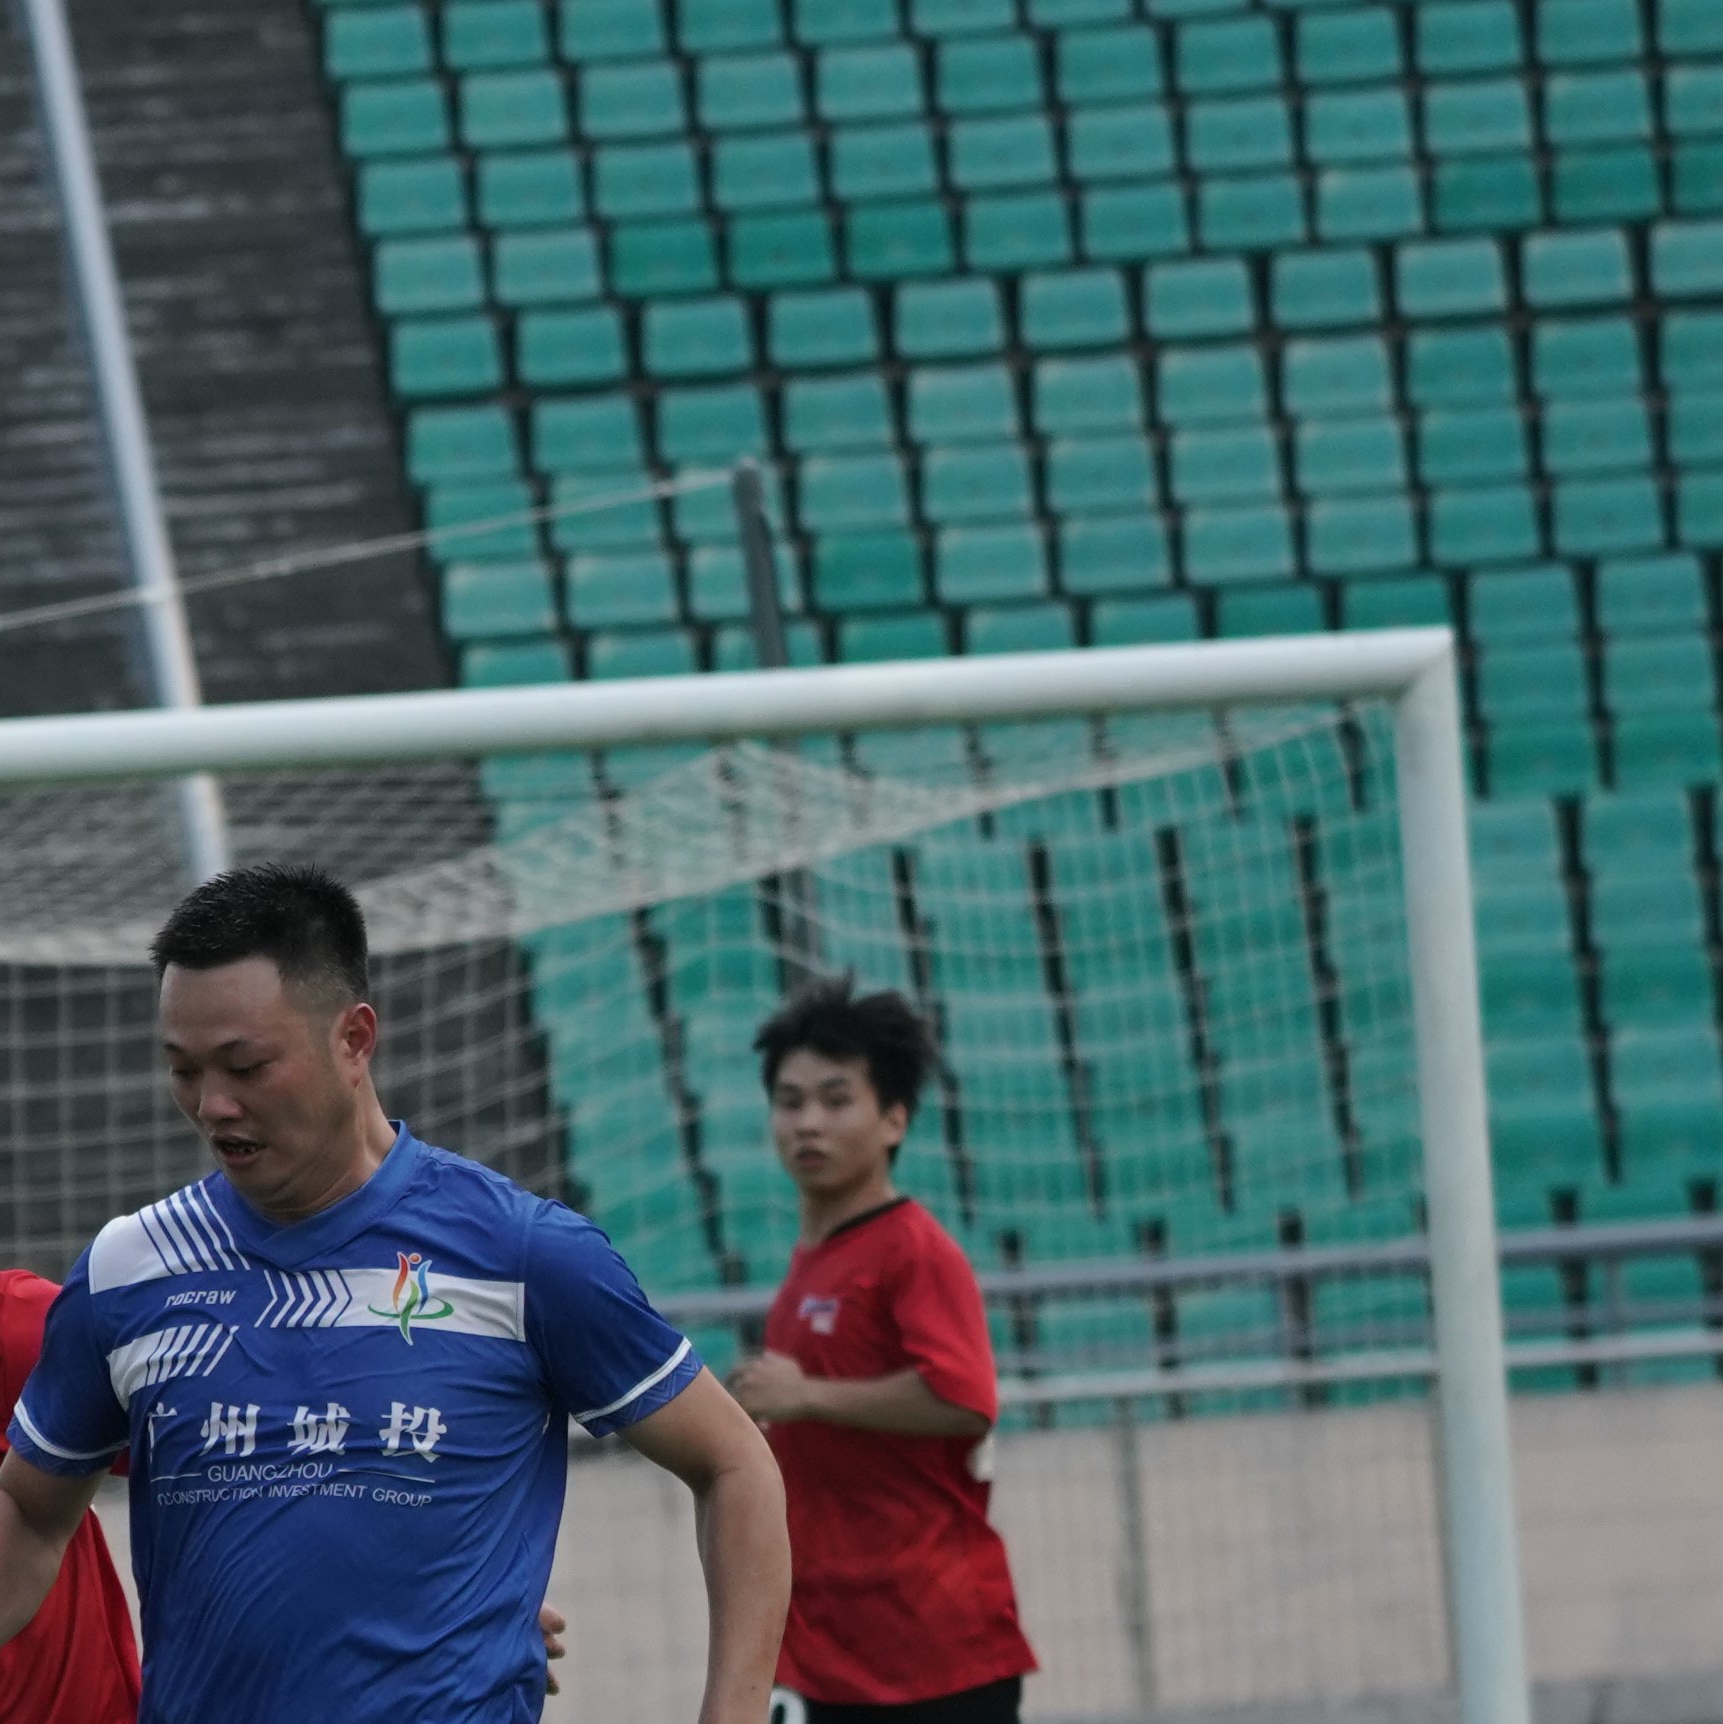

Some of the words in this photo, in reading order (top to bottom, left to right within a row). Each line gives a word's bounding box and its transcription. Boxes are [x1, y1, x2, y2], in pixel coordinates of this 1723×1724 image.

[164, 1290, 236, 1309] rocraw
[147, 1400, 448, 1463] 广州城投
[207, 1462, 334, 1483] GUANGZHOU
[268, 1483, 368, 1499] INVESTMENT
[371, 1487, 433, 1508] GROUP
